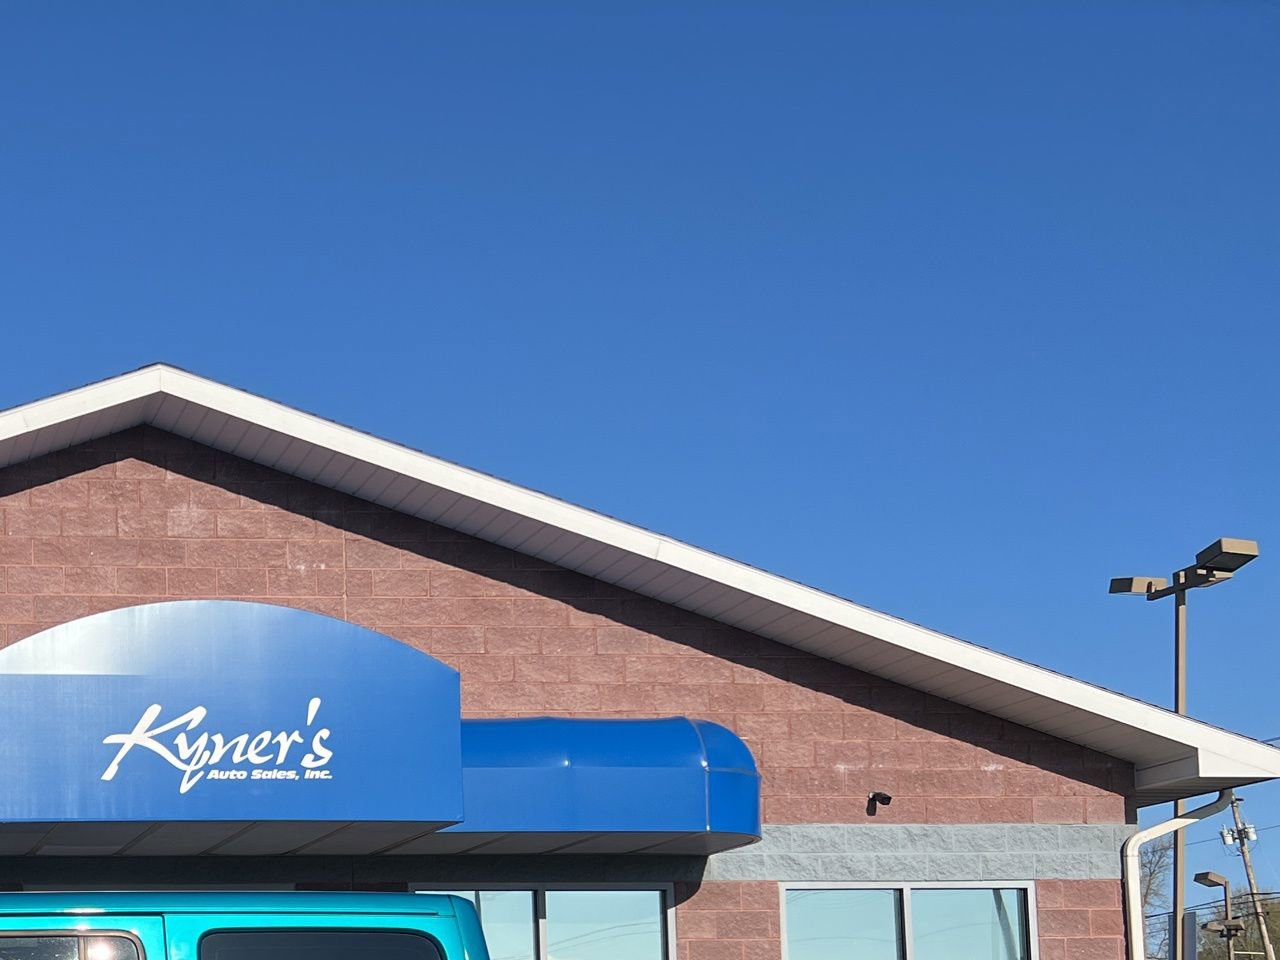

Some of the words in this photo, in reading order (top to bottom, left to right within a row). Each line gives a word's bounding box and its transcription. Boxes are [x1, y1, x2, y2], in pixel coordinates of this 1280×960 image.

[101, 697, 333, 794] Kyner's
[206, 769, 248, 780] Auto
[251, 769, 299, 781] Sales,
